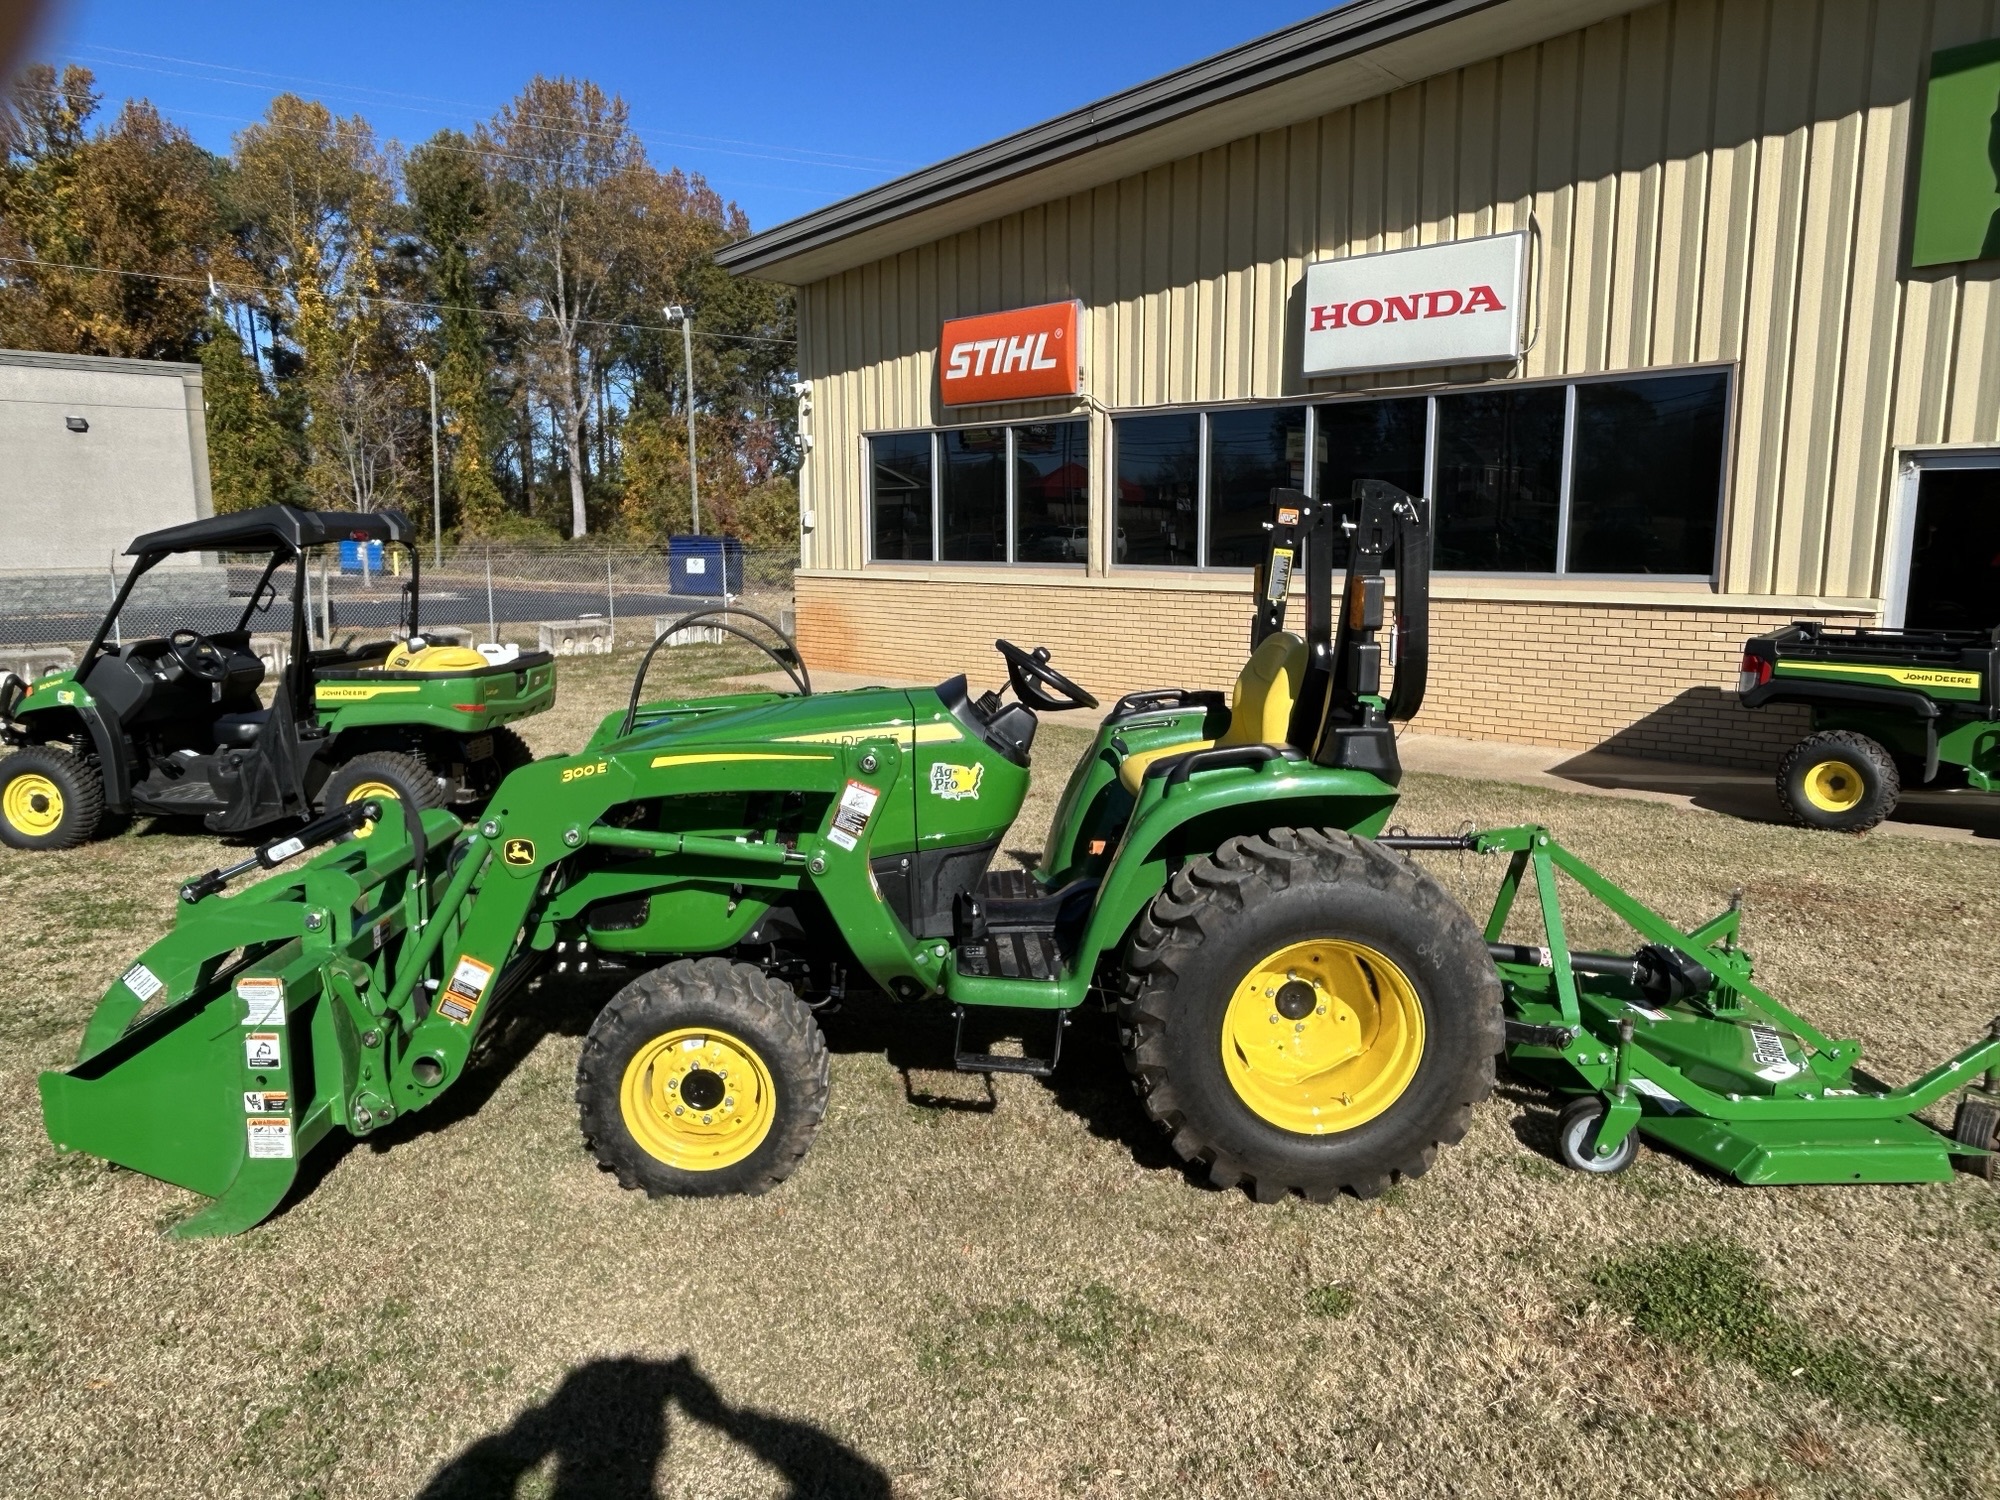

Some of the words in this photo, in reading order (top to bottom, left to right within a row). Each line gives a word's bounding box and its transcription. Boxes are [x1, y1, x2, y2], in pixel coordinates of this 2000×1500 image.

[1310, 284, 1507, 332] HONDA
[945, 331, 1057, 380] STIHL
[1903, 673, 1932, 682] JOHN
[1935, 675, 1972, 684] DEERE
[562, 764, 595, 783] 300
[597, 762, 608, 774] E
[934, 778, 959, 791] Pro
